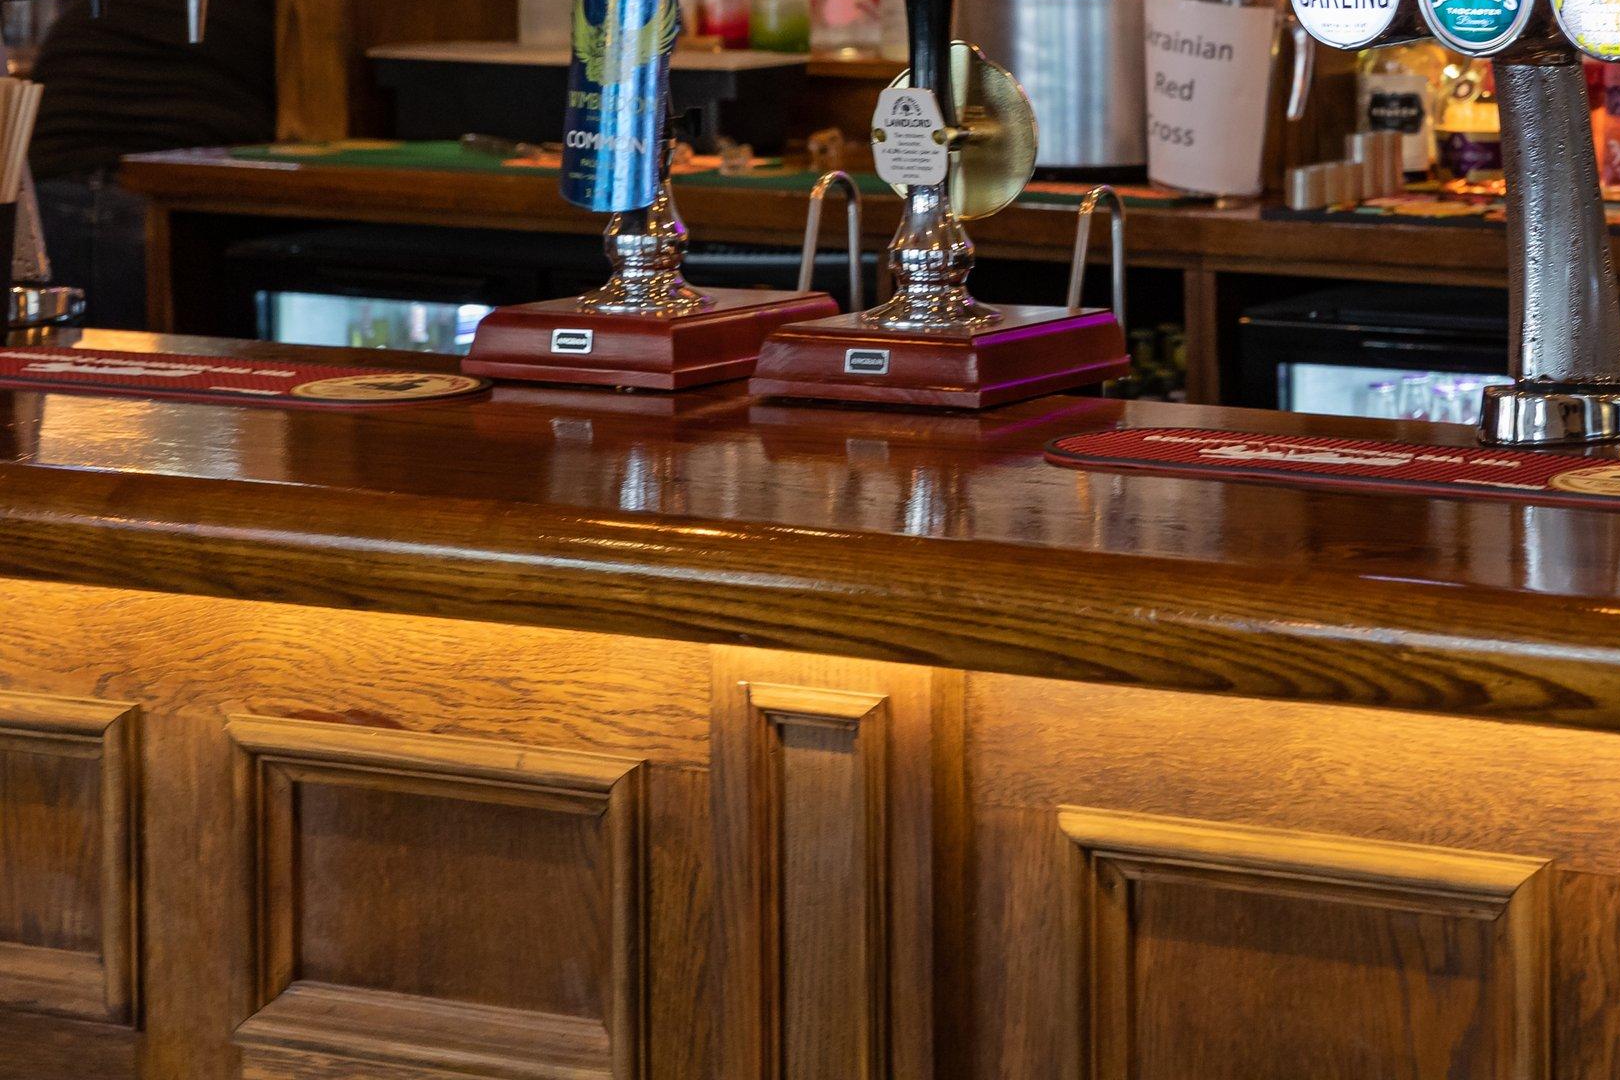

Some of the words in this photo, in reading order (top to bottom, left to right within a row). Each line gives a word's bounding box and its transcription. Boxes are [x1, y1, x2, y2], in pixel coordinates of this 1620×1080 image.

[1155, 71, 1196, 102] Red
[565, 129, 649, 155] COMMON
[1149, 119, 1195, 148] ross
